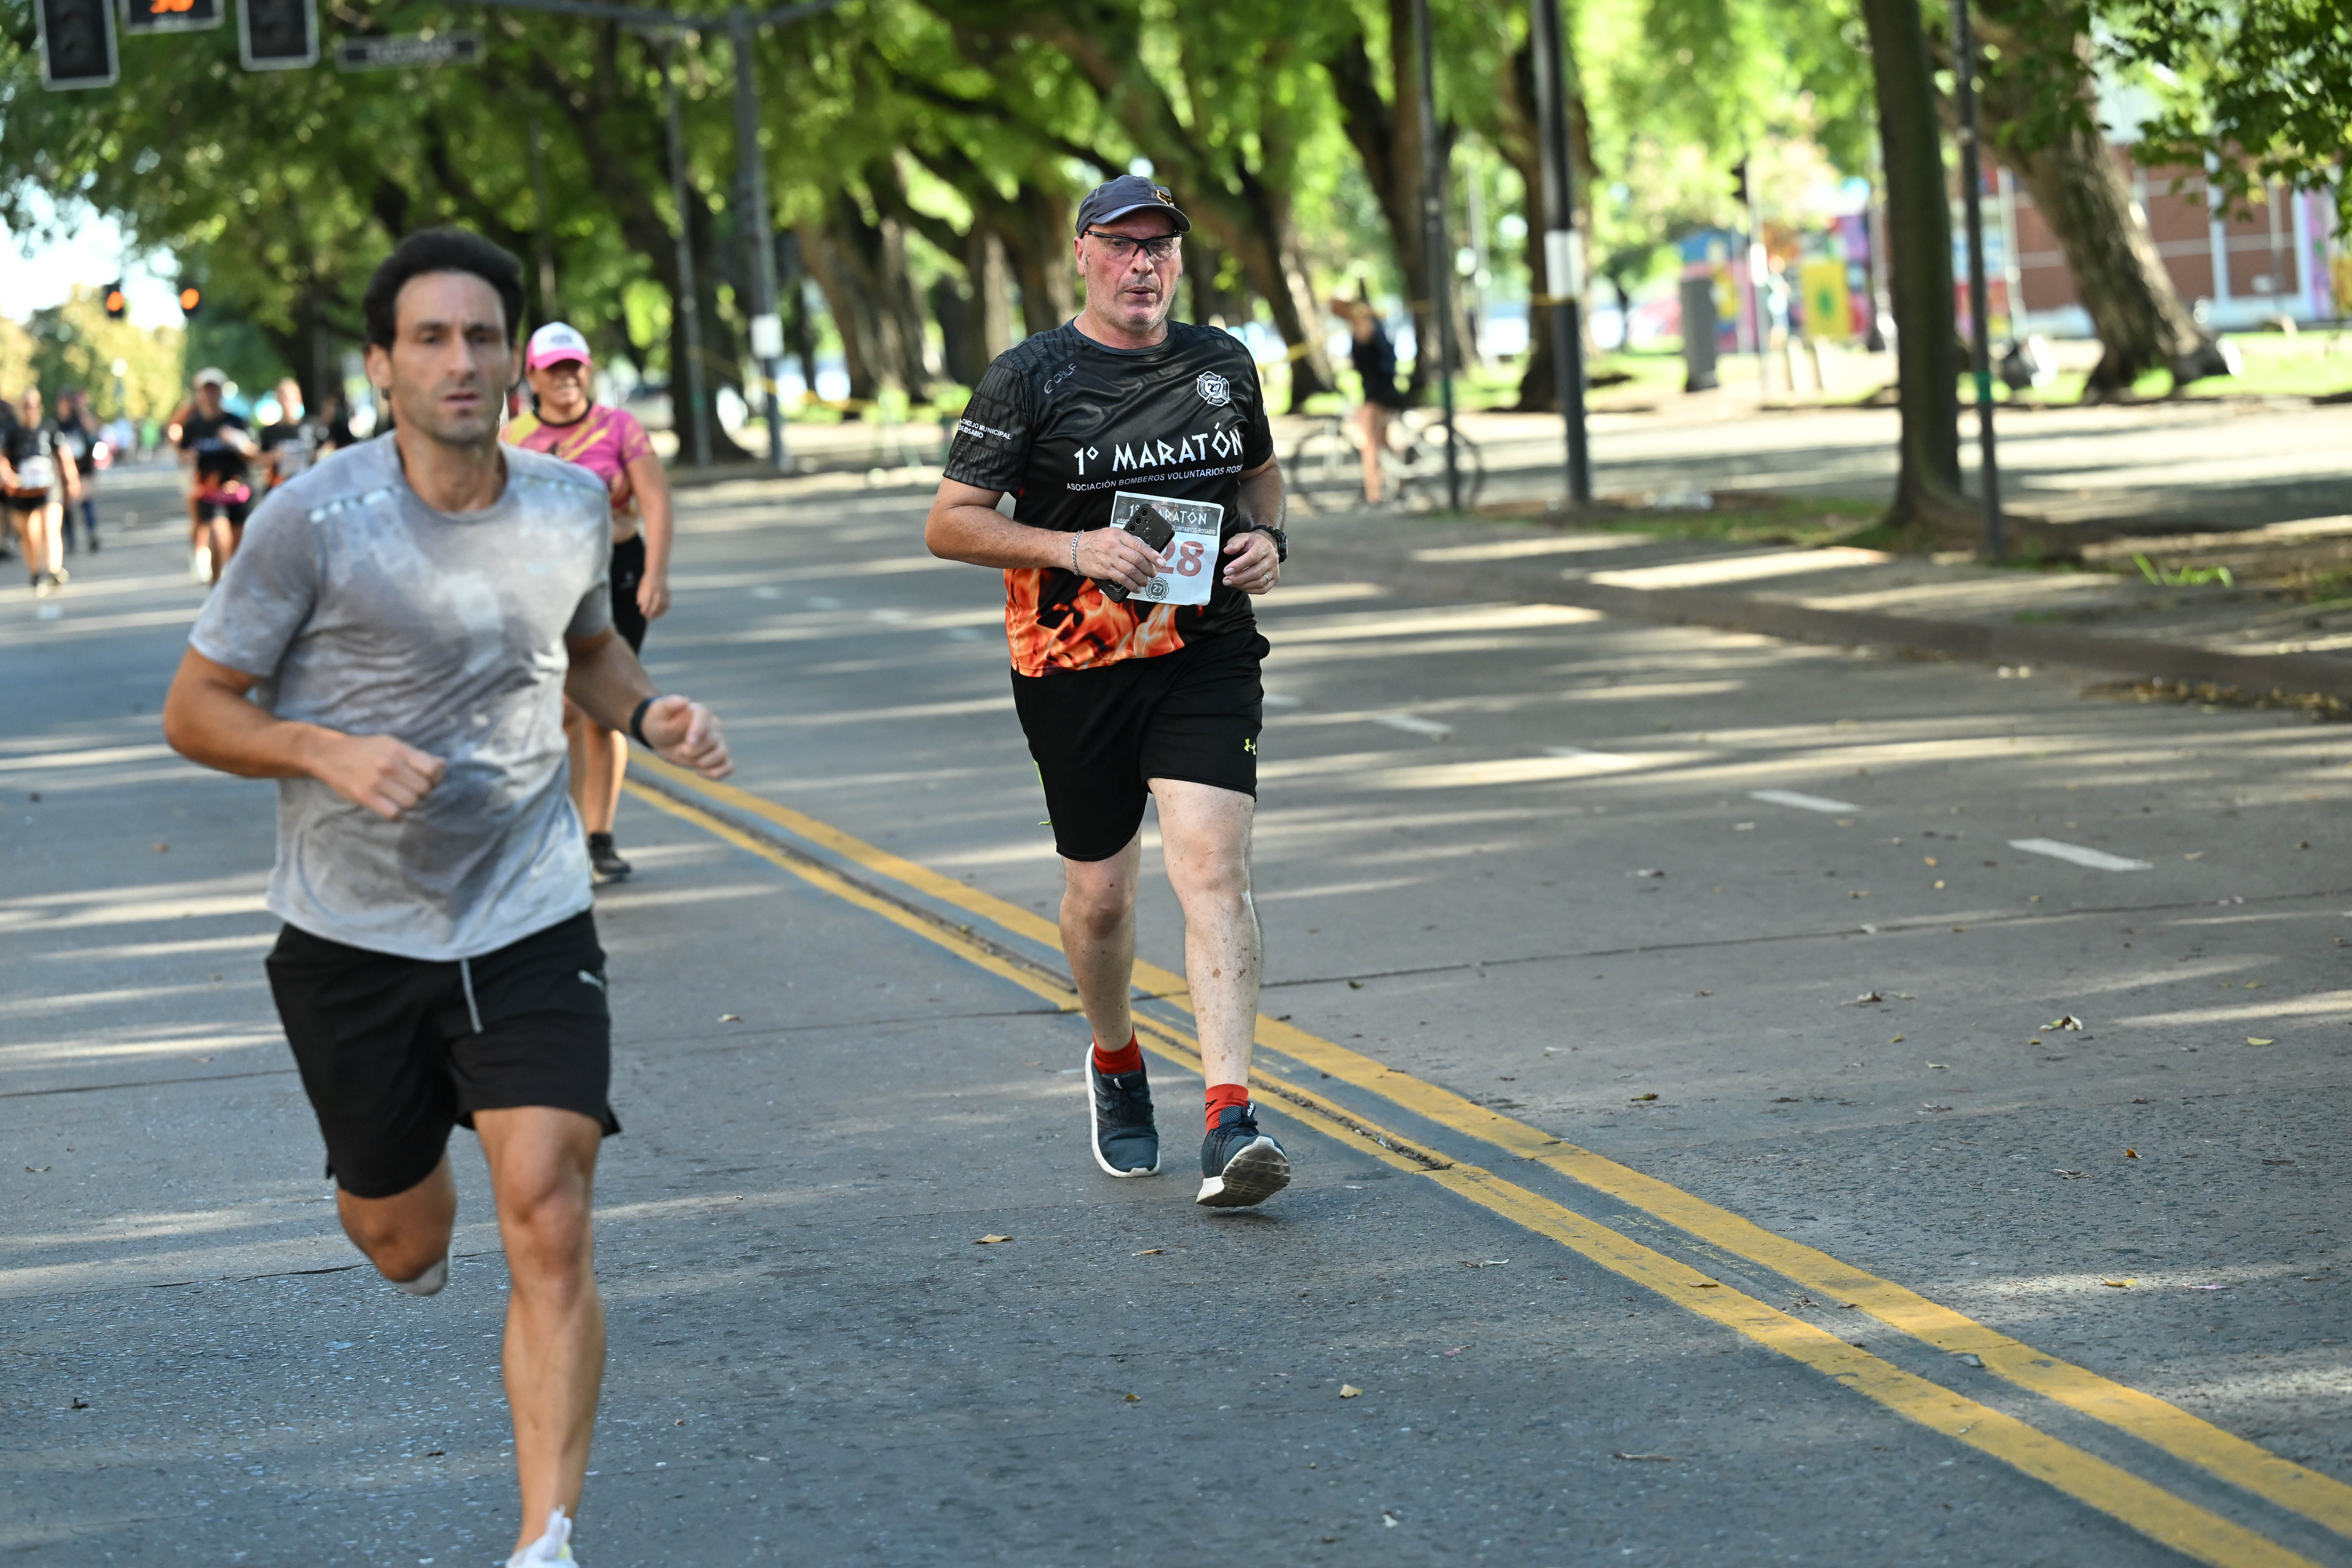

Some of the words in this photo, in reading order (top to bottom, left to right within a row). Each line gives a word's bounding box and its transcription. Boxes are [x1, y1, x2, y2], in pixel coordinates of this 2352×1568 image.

[1208, 383, 1221, 393] 27
[979, 424, 1011, 440] MUNICIPAL
[1112, 422, 1243, 472] MARATÓN
[1067, 480, 1116, 491] ASOCIACIÓN
[1118, 474, 1165, 486] BOMBEROS
[1167, 467, 1225, 481] VOLUNTARIOS
[1153, 584, 1163, 593] 27
